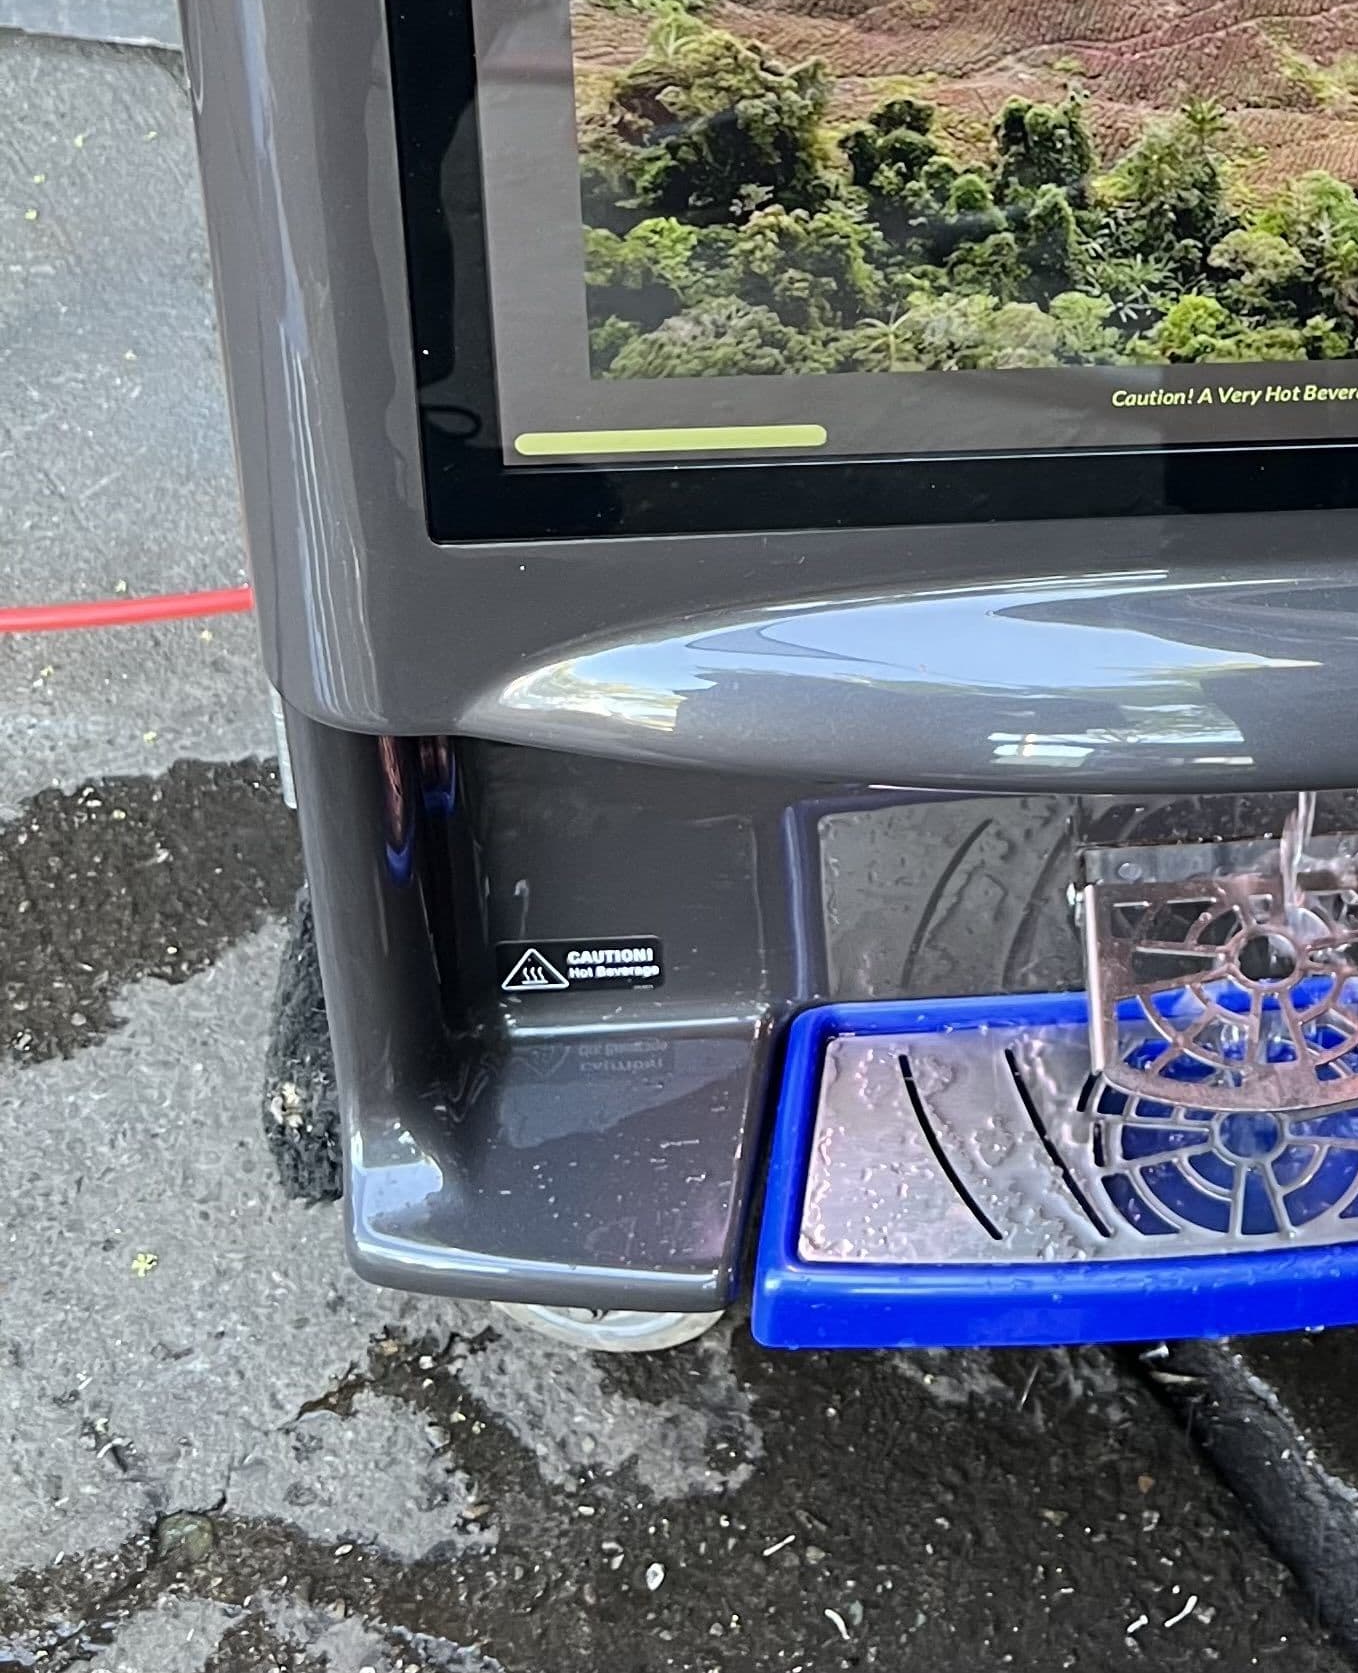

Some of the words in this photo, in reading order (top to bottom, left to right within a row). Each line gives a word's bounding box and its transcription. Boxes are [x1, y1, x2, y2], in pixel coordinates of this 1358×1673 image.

[1111, 388, 1194, 407] Caution!
[1197, 388, 1213, 404] A
[1218, 386, 1262, 406] Very
[1265, 386, 1301, 402] Hot
[567, 948, 653, 965] CAUTION!
[568, 967, 593, 979] Hot
[595, 965, 660, 978] Beverage
